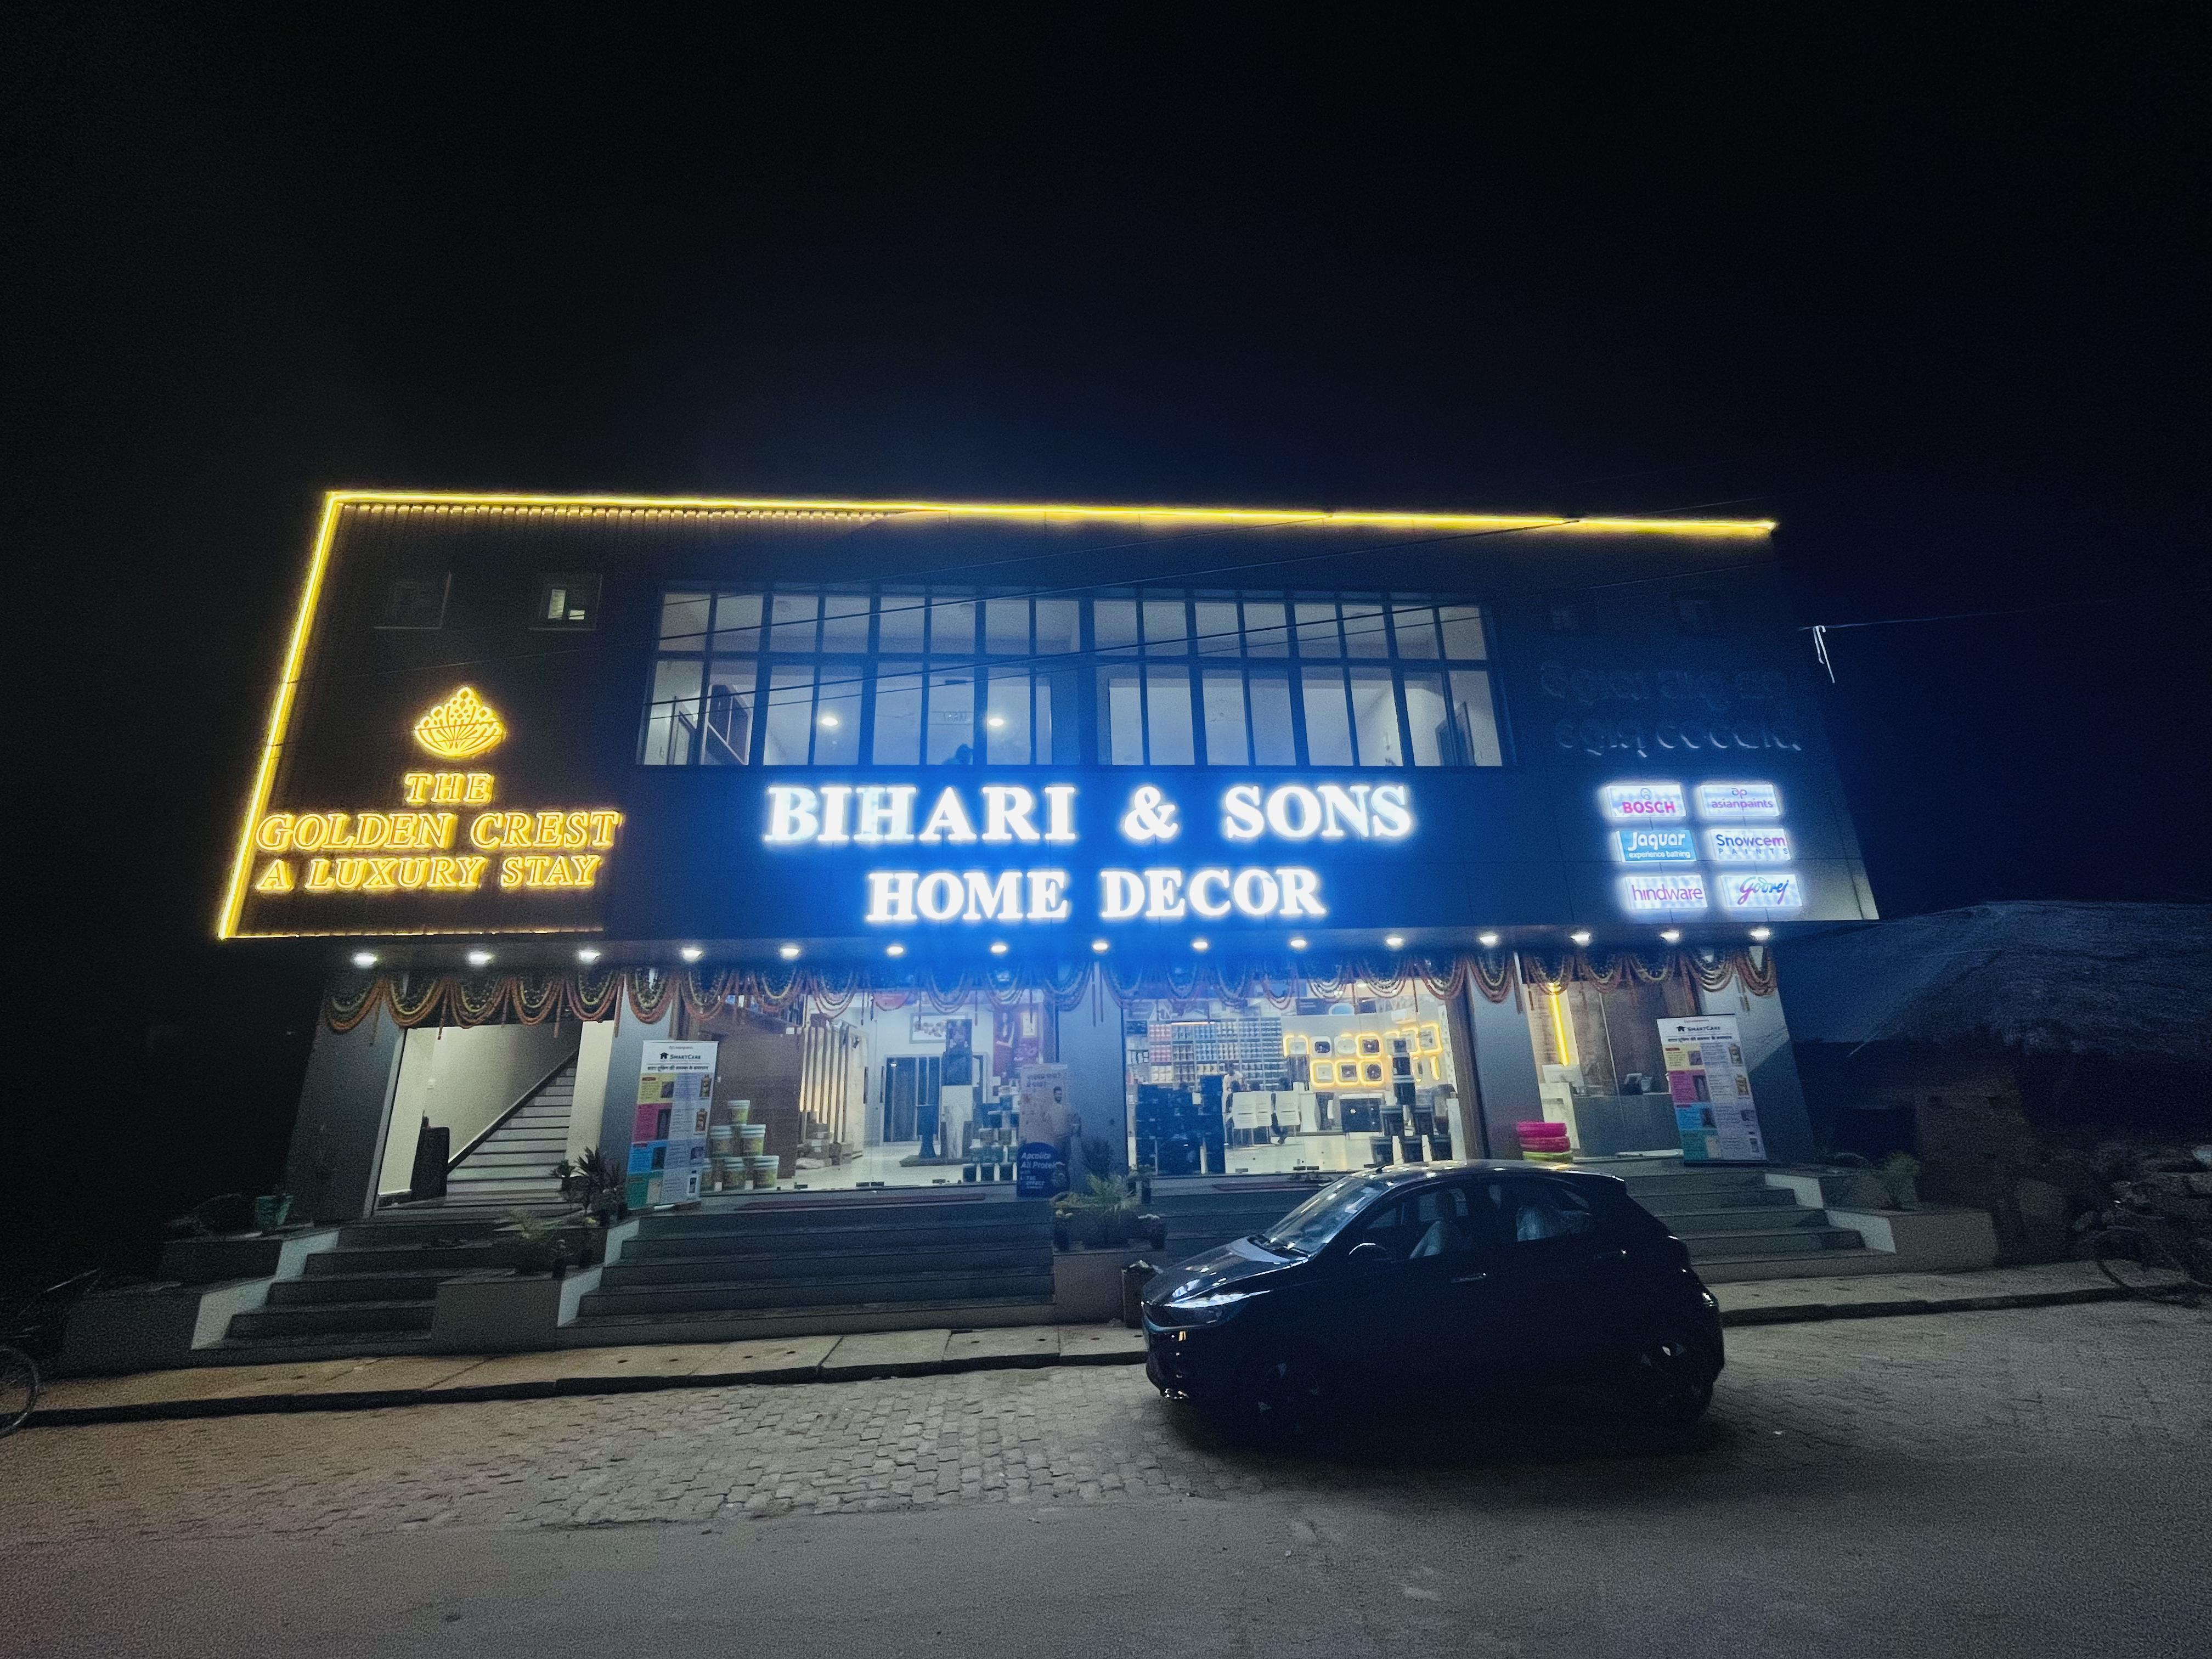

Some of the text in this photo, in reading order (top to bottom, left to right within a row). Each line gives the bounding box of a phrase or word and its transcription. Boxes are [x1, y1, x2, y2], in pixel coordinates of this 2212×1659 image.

[404, 772, 494, 804] THE
[765, 785, 1412, 842] BIHARI & SONS
[1622, 801, 1676, 814] BOSCH
[1711, 798, 1774, 812] asianpaints
[256, 810, 623, 850] GOLDEN CREST
[1628, 831, 1686, 851] Jaquar
[1716, 834, 1786, 846] Snowcem
[256, 854, 602, 891] A LUXURY STAY
[866, 867, 1326, 922] HOME DECOR
[1632, 884, 1704, 901] hindware
[1737, 876, 1790, 905] Godrej
